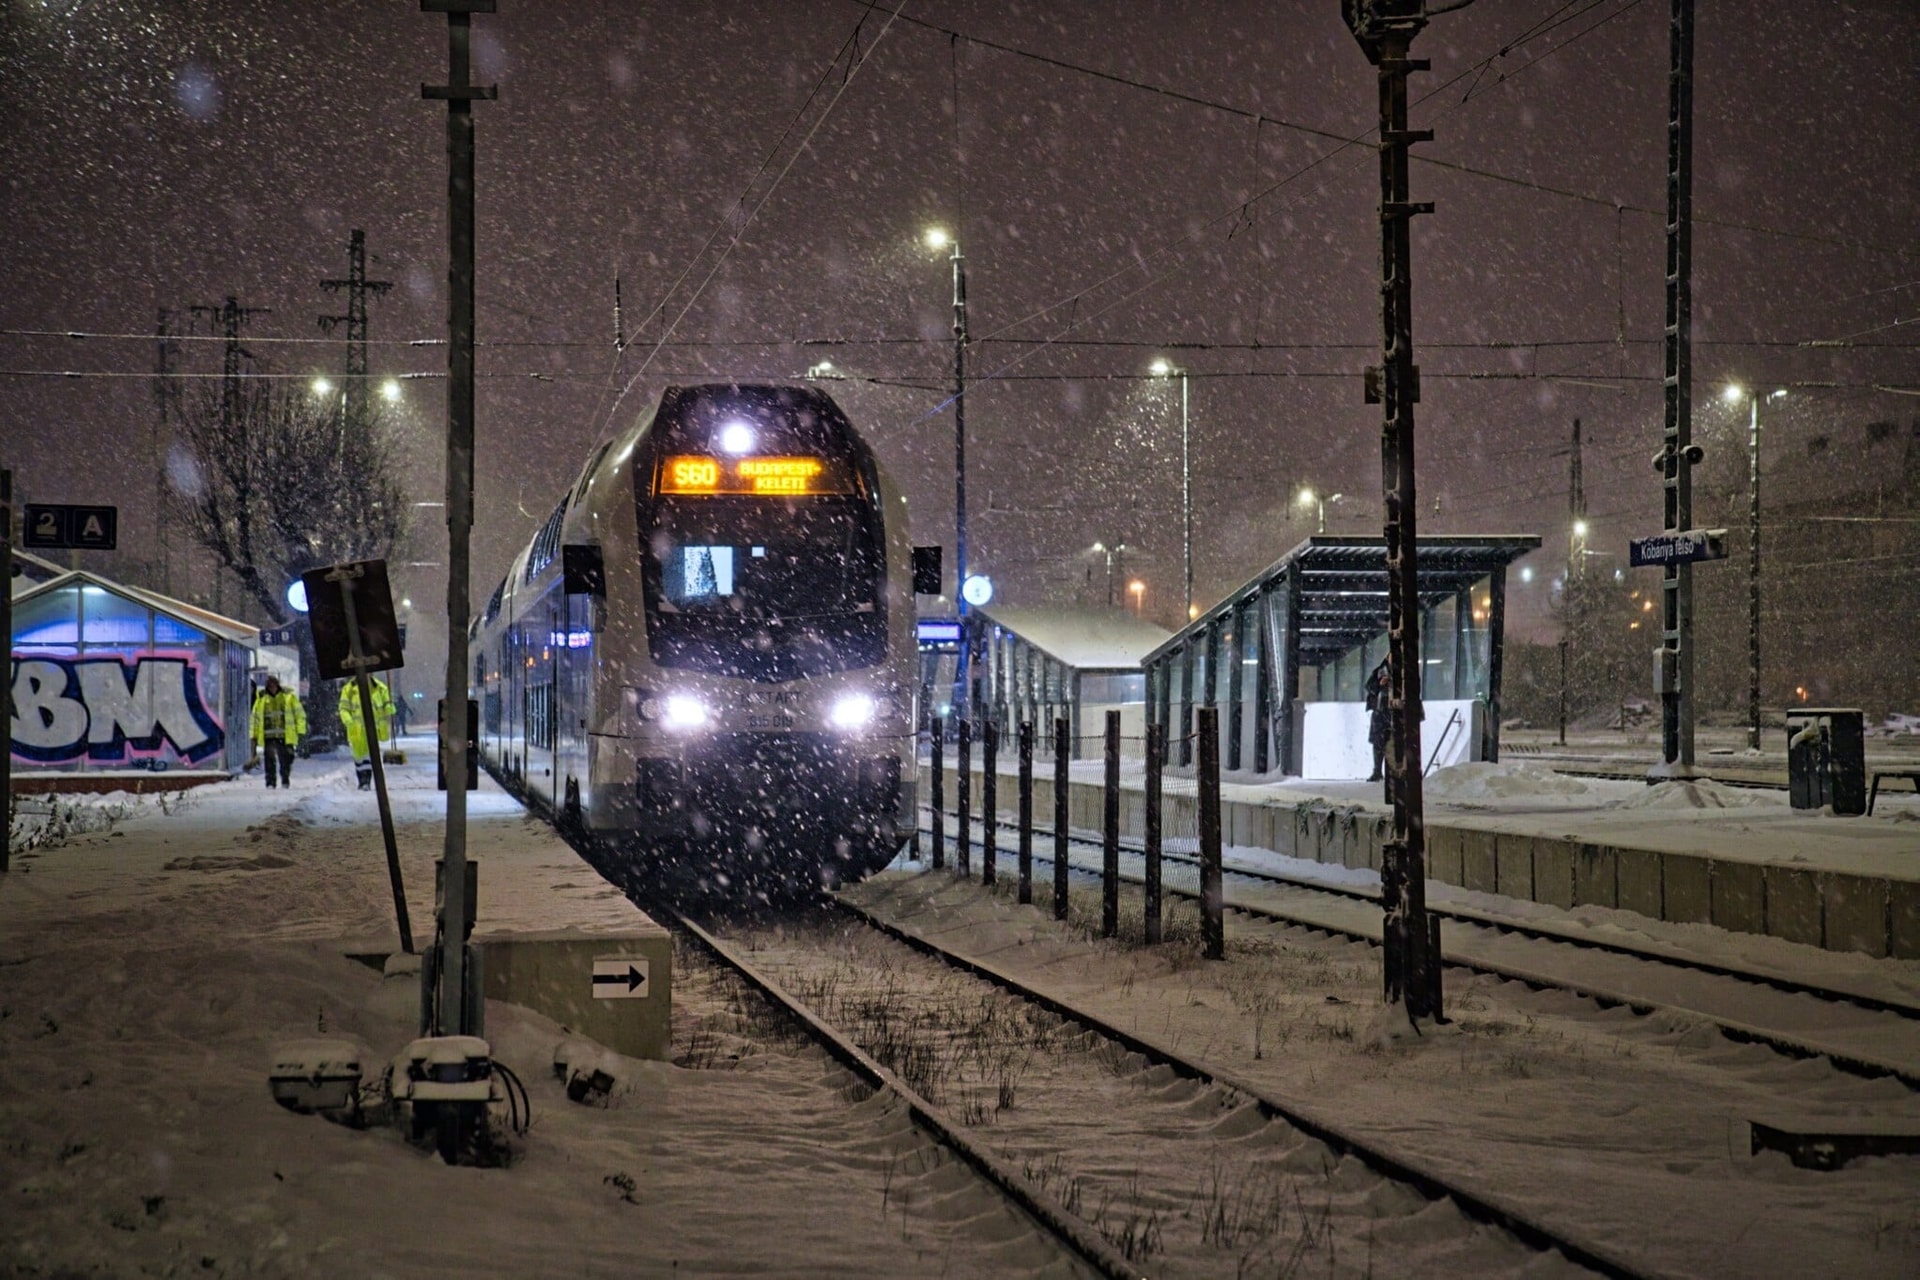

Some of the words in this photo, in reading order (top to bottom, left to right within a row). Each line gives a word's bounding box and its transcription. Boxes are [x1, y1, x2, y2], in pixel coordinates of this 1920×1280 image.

[674, 461, 717, 486] S60
[755, 476, 807, 490] KELETI
[36, 512, 57, 535] 2
[82, 515, 103, 536] A
[1641, 541, 1674, 561] Kőbánya
[264, 632, 272, 642] 2
